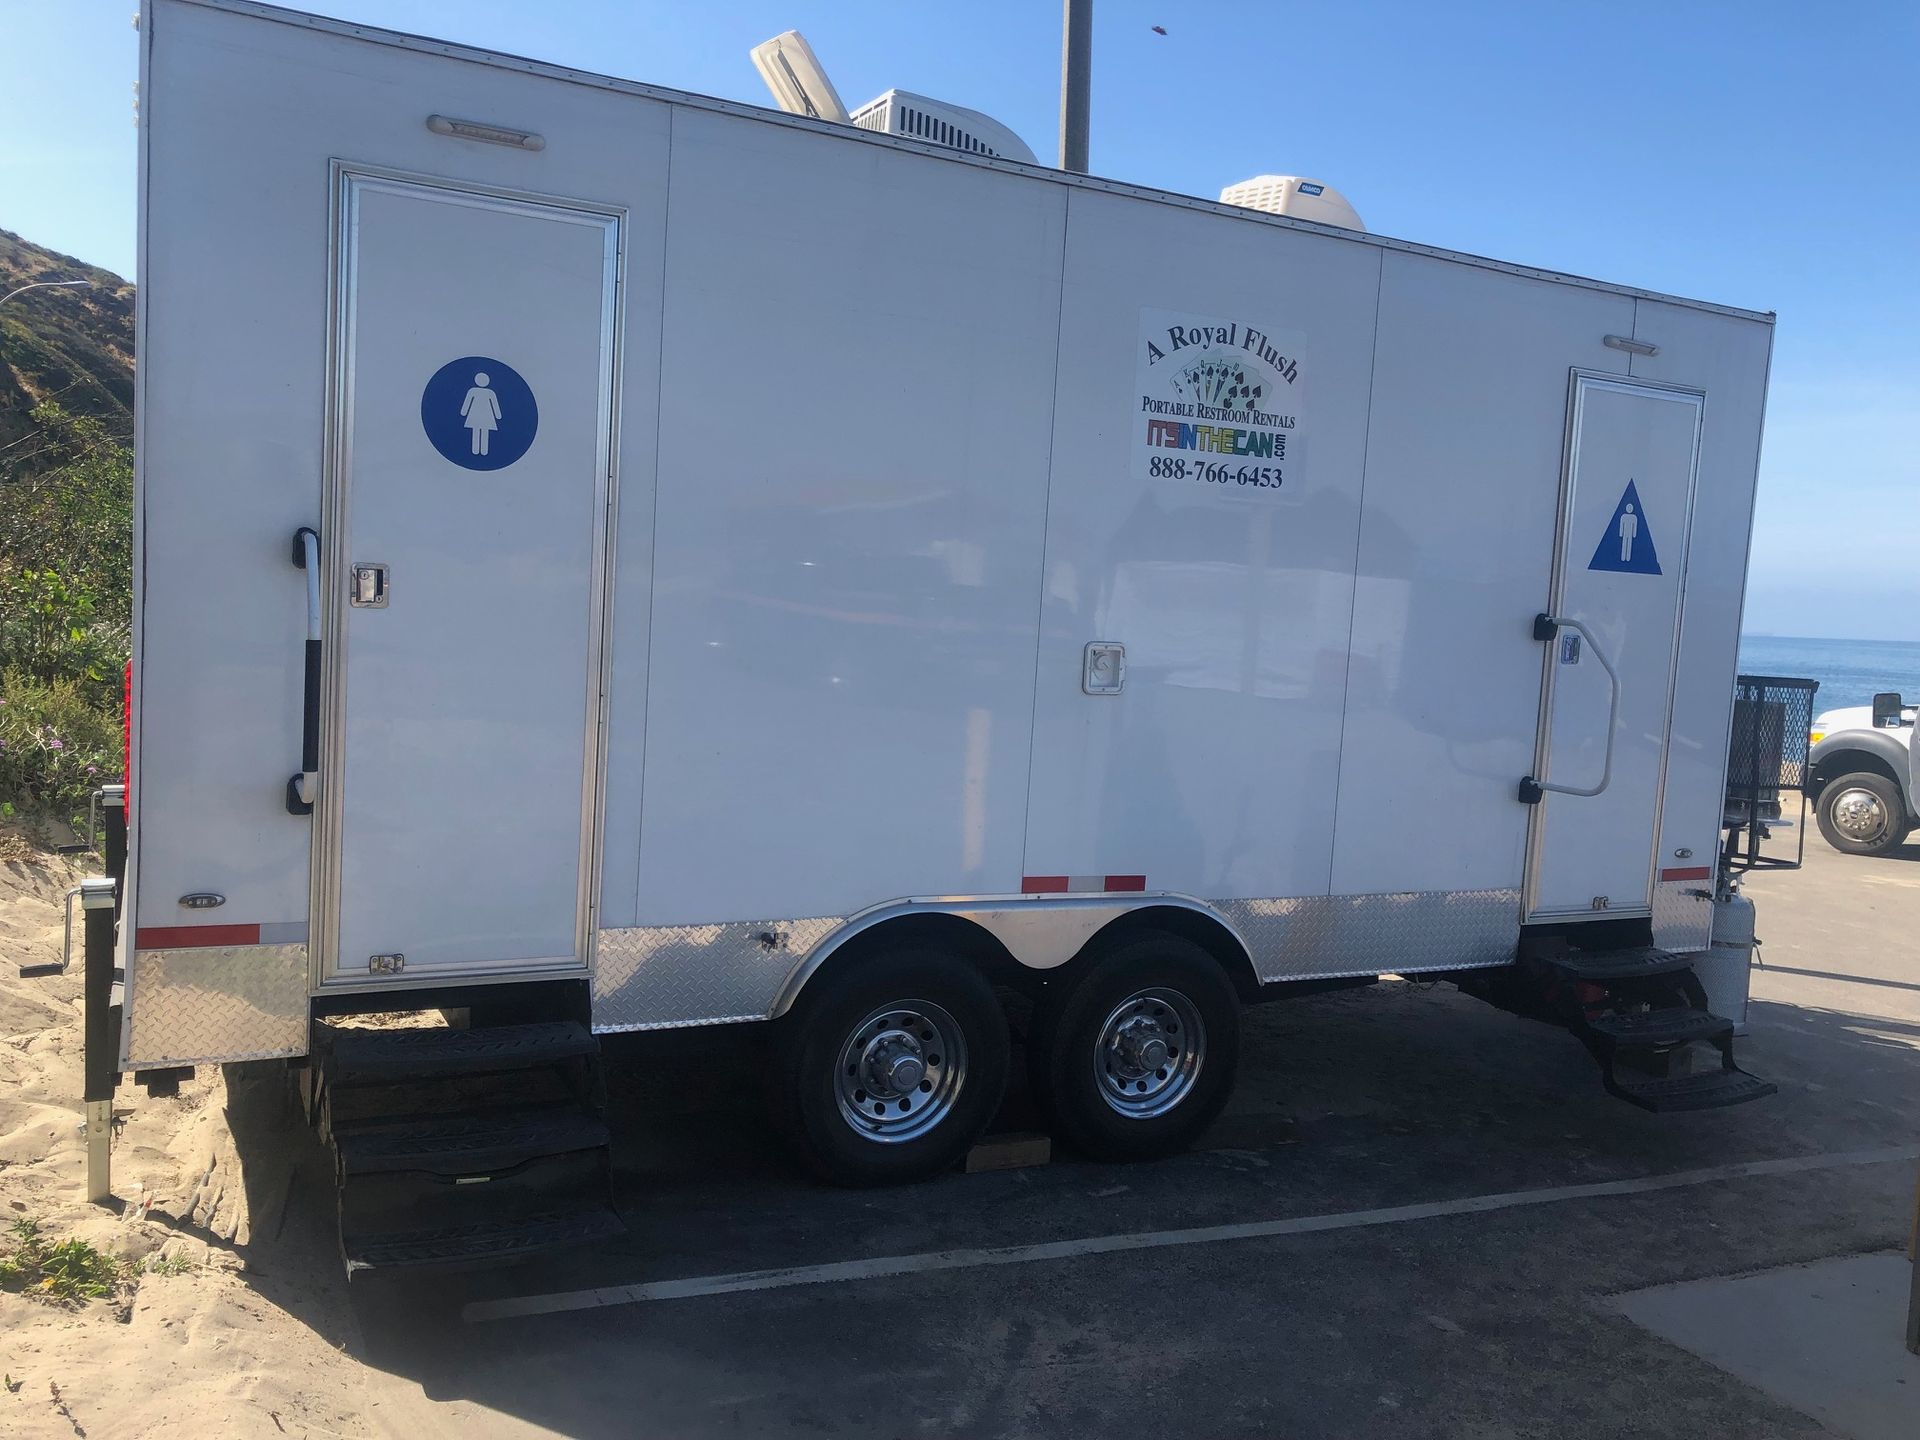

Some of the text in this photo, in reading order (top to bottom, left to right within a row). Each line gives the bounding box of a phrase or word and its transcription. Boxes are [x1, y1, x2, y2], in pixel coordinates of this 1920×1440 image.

[1147, 323, 1298, 384] A Royal Flush
[1142, 396, 1295, 429] PORTABLE RESTROOM RENTALS
[1149, 456, 1283, 489] 888-766-6453
